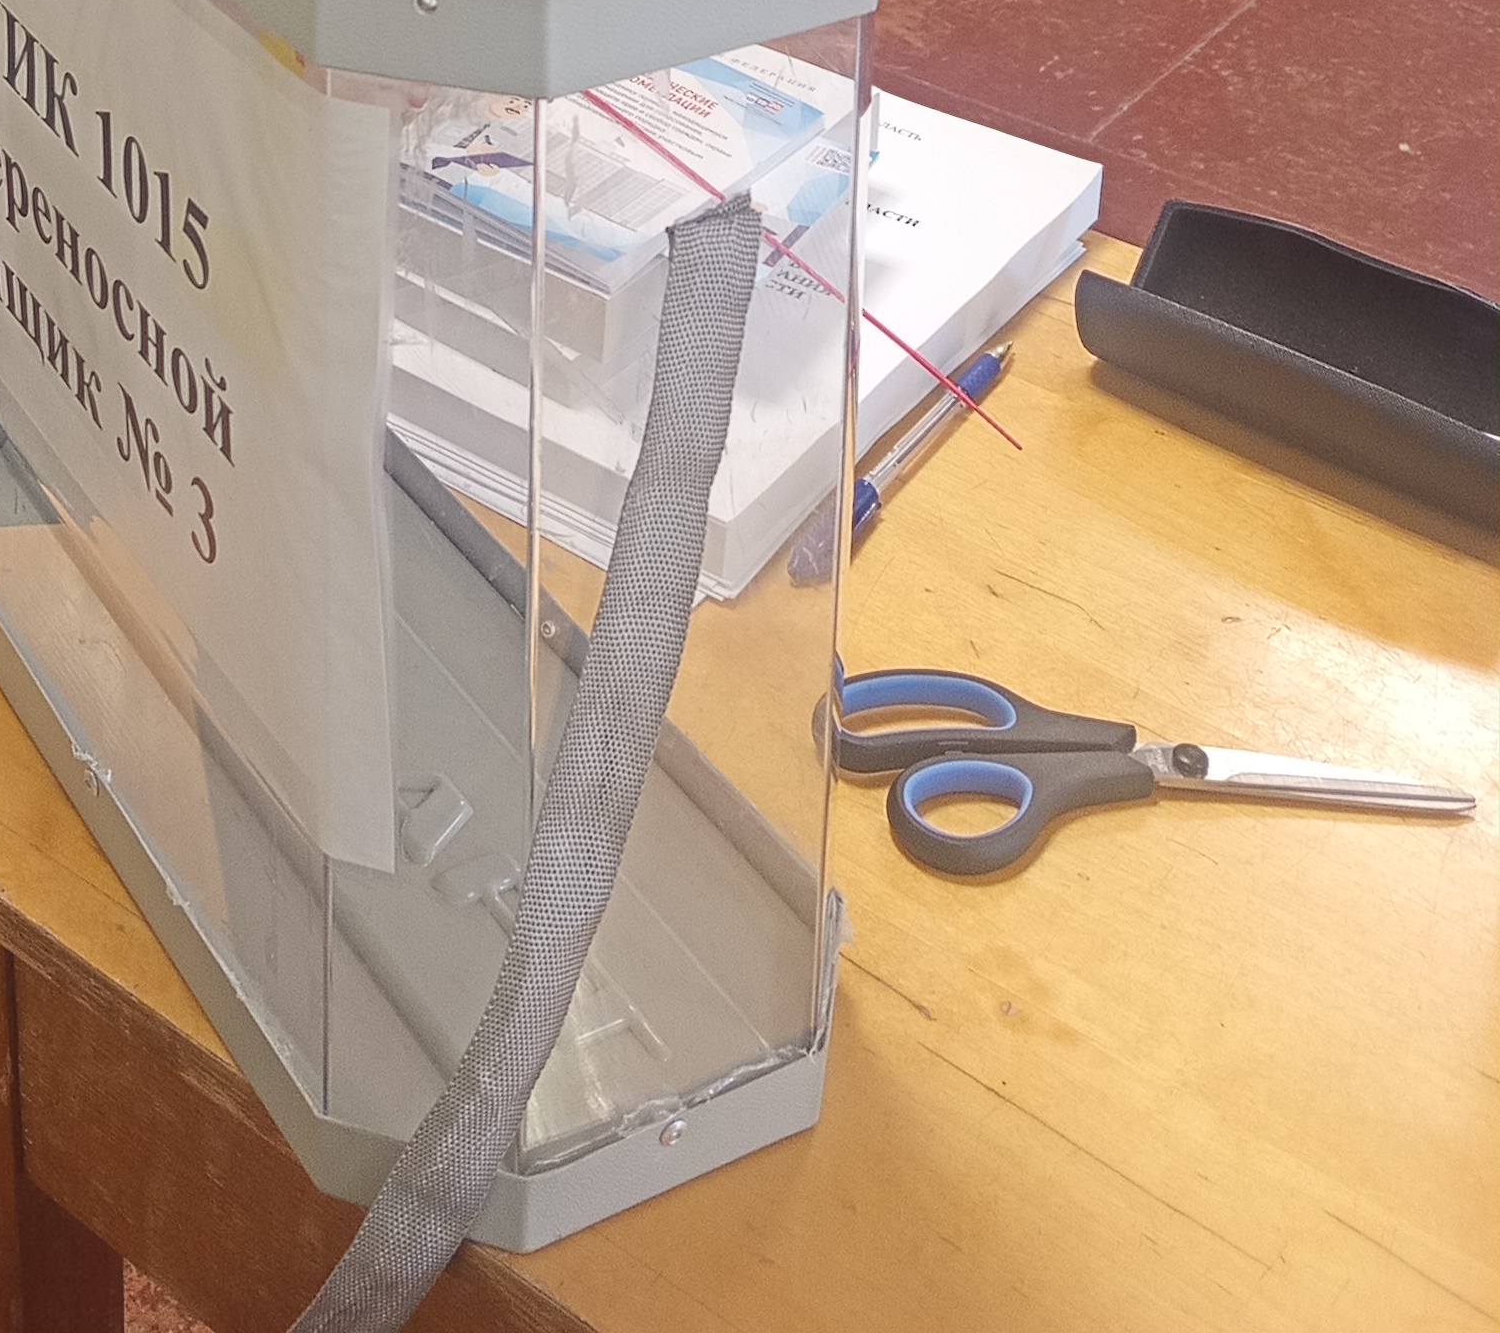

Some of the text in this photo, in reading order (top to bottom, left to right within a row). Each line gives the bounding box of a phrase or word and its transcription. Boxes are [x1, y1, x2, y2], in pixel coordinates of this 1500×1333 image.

[95, 110, 210, 289] 1015
[117, 381, 173, 517] №
[191, 476, 217, 564] 3
